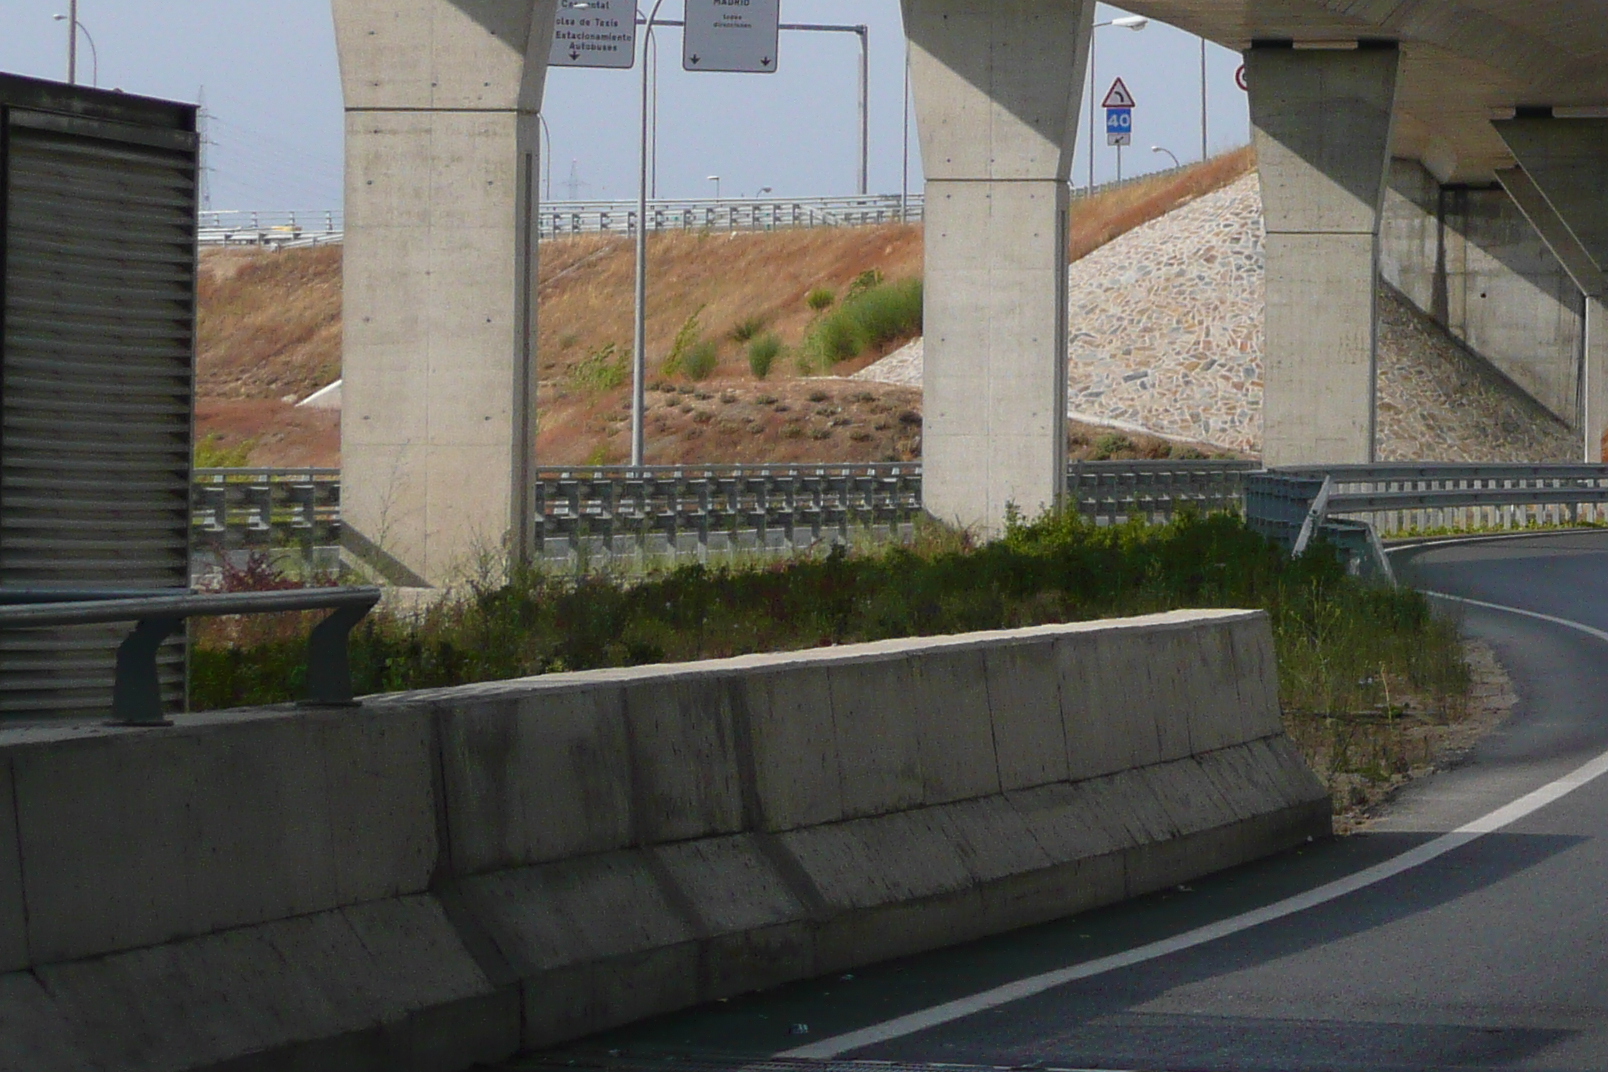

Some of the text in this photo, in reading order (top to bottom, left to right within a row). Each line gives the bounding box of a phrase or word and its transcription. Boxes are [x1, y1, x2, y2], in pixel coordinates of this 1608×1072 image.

[579, 18, 591, 26] de
[555, 31, 632, 42] Estacionamiento
[569, 42, 617, 51] Autobuses
[1107, 114, 1130, 127] 40
